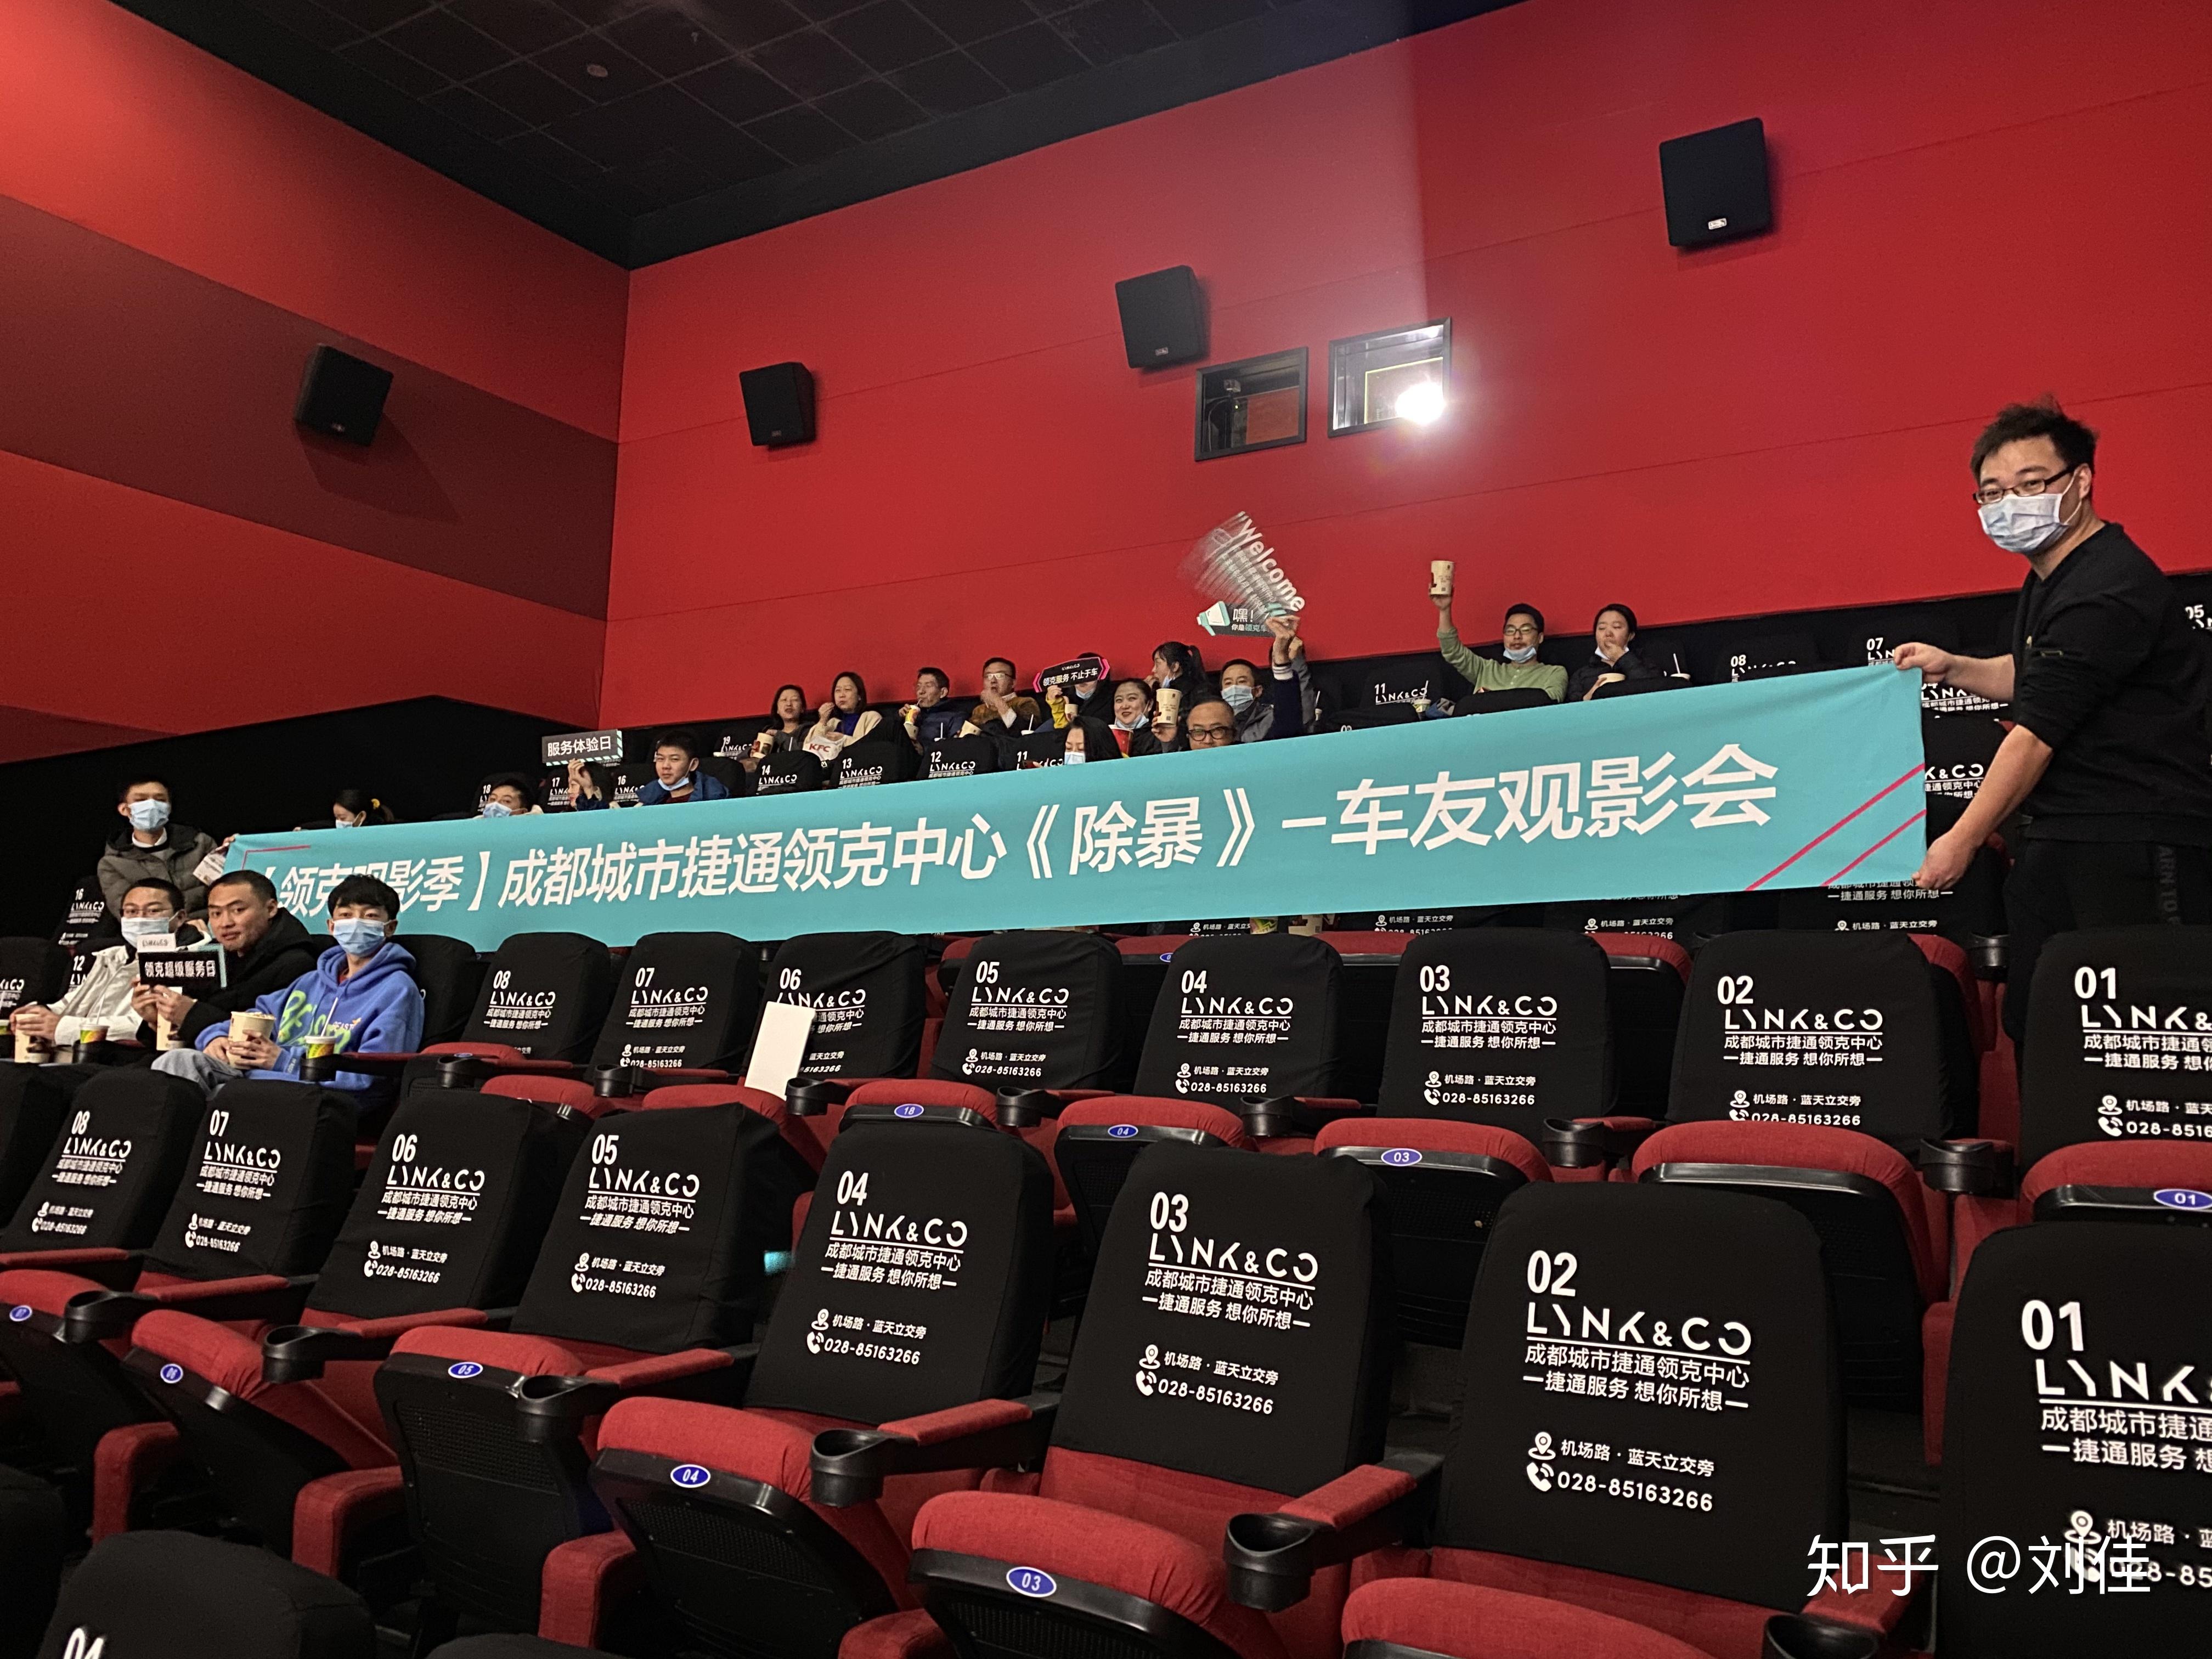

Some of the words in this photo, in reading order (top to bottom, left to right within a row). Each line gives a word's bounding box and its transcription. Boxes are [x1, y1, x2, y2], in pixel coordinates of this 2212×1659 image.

[1231, 518, 1305, 612] Welcome
[1866, 637, 1883, 650] 07
[1731, 654, 1746, 667] 08
[1071, 668, 1098, 680] 不止于车
[1374, 683, 1385, 695] 11
[548, 736, 611, 757] 服务体验日
[809, 743, 831, 752] KFC
[1017, 751, 1028, 760] 11
[843, 758, 852, 769] 13
[930, 751, 941, 763] 12
[761, 765, 770, 775] 14
[483, 785, 491, 793] 18
[552, 777, 560, 786] 17
[618, 775, 626, 785] 16
[75, 888, 83, 900] 16
[73, 956, 85, 970] 12
[493, 970, 511, 989] 08
[635, 968, 654, 988] 07
[780, 968, 802, 990] 06
[976, 961, 1000, 984] 05
[1181, 970, 1207, 993] 04
[1420, 965, 1450, 992] 03
[1717, 976, 1753, 1005] 02
[2074, 967, 2116, 999] 01
[969, 1007, 1066, 1019] 成都城市捷通领克中心
[1179, 1018, 1290, 1031] 成都城市捷通领克中心
[1421, 1021, 1556, 1034] 成都城市捷通领克中心
[1724, 1036, 1882, 1050] 成都城市捷通领克中心
[974, 1065, 1041, 1077] 028-85163266
[1190, 1082, 1267, 1093] 028-85163266
[1442, 1092, 1535, 1105] 028-85163266
[904, 1107, 916, 1115] 18
[1752, 1113, 1860, 1125] 028-85163266
[71, 1111, 90, 1134] 08
[210, 1110, 229, 1136] 07
[1117, 1127, 1128, 1136] 04
[392, 1135, 417, 1162] 06
[591, 1135, 619, 1165] 05
[1394, 1152, 1409, 1162] 03
[837, 1171, 868, 1206] 04
[585, 1195, 694, 1218] 成都城市捷通领克中心
[2175, 1193, 2196, 1205] 01
[1150, 1192, 1188, 1232] 03
[825, 1242, 961, 1272] 成都城市捷通领克中心
[376, 1265, 440, 1283] 028-85163266
[1527, 1250, 1577, 1296] 02
[586, 1278, 656, 1298] 028-85163266
[1144, 1269, 1313, 1311] 成都城市捷通领克中心
[2022, 1300, 2084, 1351] 01
[825, 1338, 920, 1364] 028-85163266
[458, 1365, 474, 1375] 05
[1525, 1344, 1750, 1388] 成都城市捷通领克中心
[2035, 1359, 2212, 1403] LYNK
[1158, 1379, 1273, 1414] 028-85163266
[681, 1469, 700, 1483] 04
[1558, 1471, 1713, 1511] 028-85163266
[1020, 1572, 1041, 1592] 03
